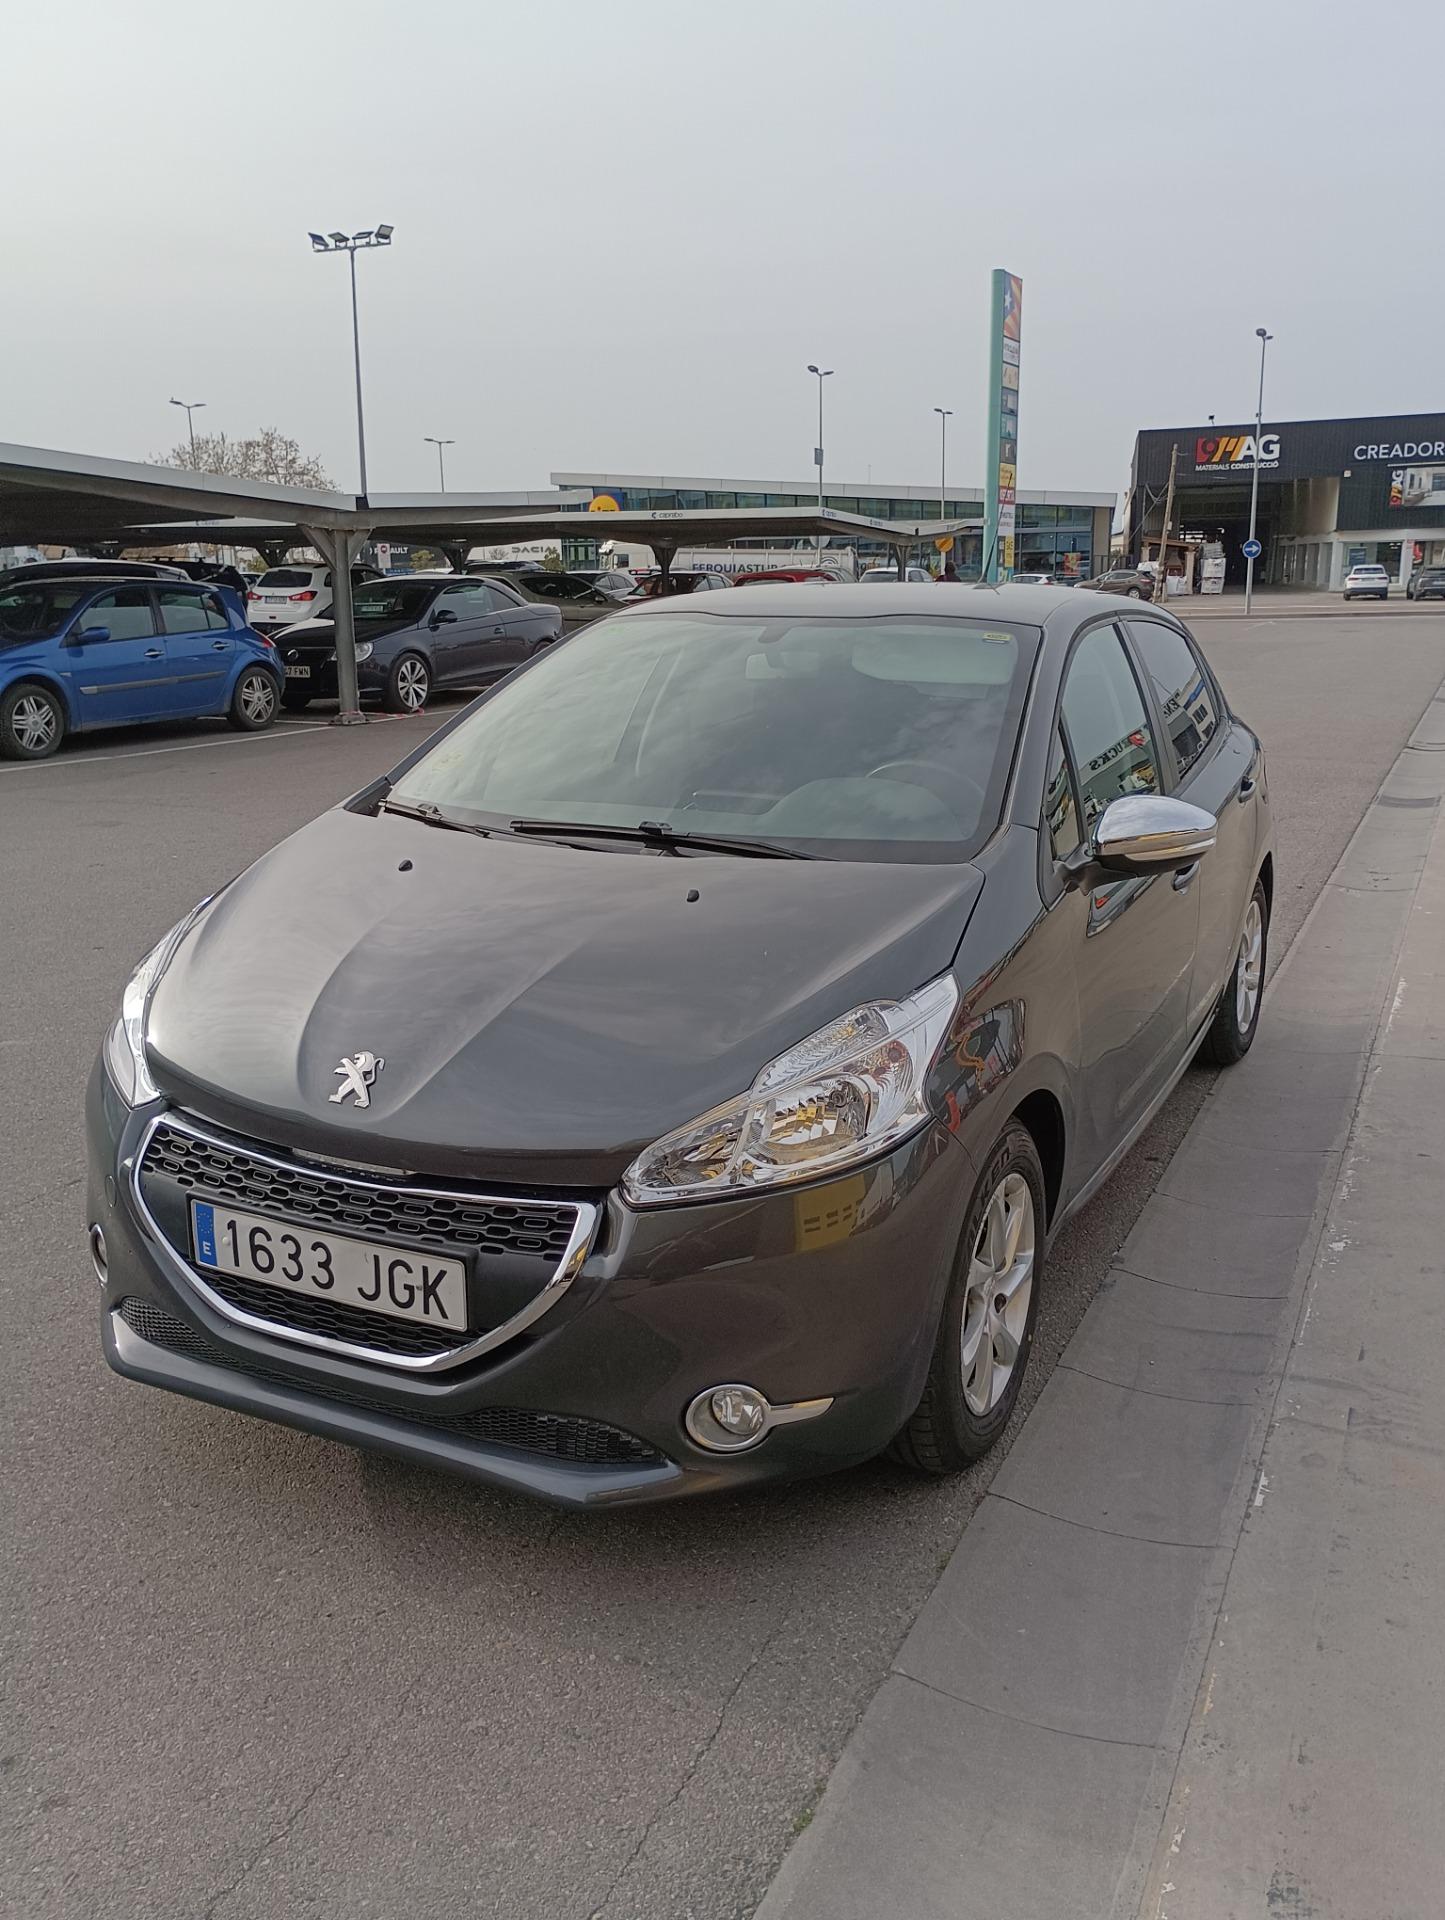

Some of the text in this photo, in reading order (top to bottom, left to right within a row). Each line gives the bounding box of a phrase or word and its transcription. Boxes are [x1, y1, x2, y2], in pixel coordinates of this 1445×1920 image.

[1195, 460, 1279, 471] MATERIALS CONSTUCCIÓ
[202, 1219, 449, 1320] E 1633 JGK
